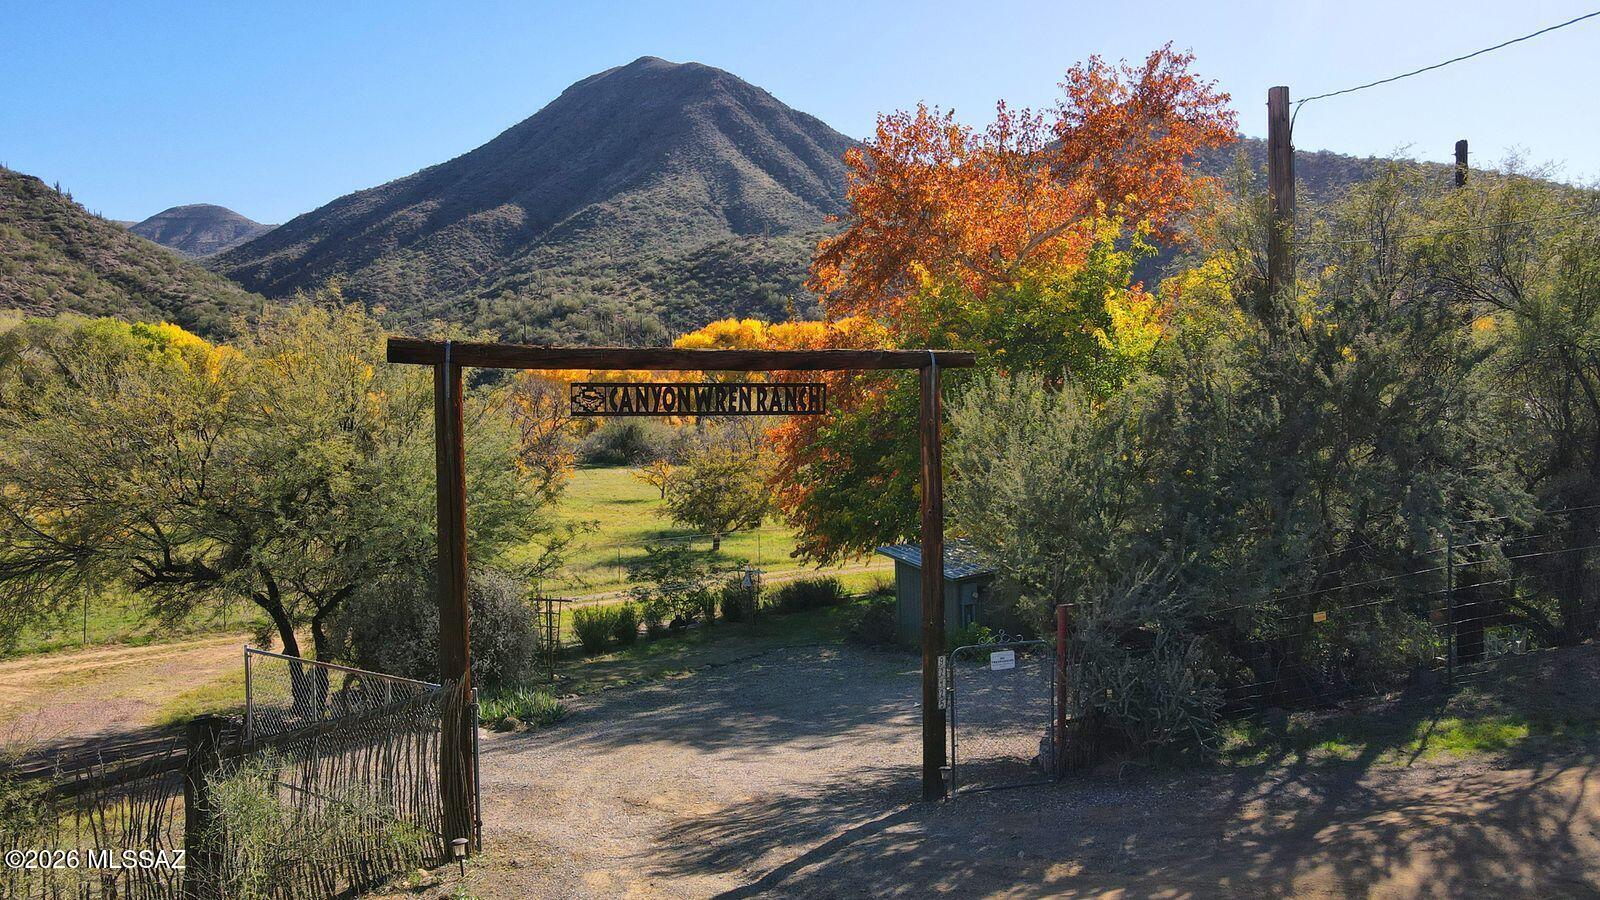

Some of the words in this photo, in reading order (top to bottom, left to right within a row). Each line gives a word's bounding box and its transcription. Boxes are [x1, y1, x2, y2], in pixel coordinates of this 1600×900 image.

[609, 385, 691, 413] CANYON
[694, 385, 751, 413] WREN
[756, 385, 820, 413] RANCH
